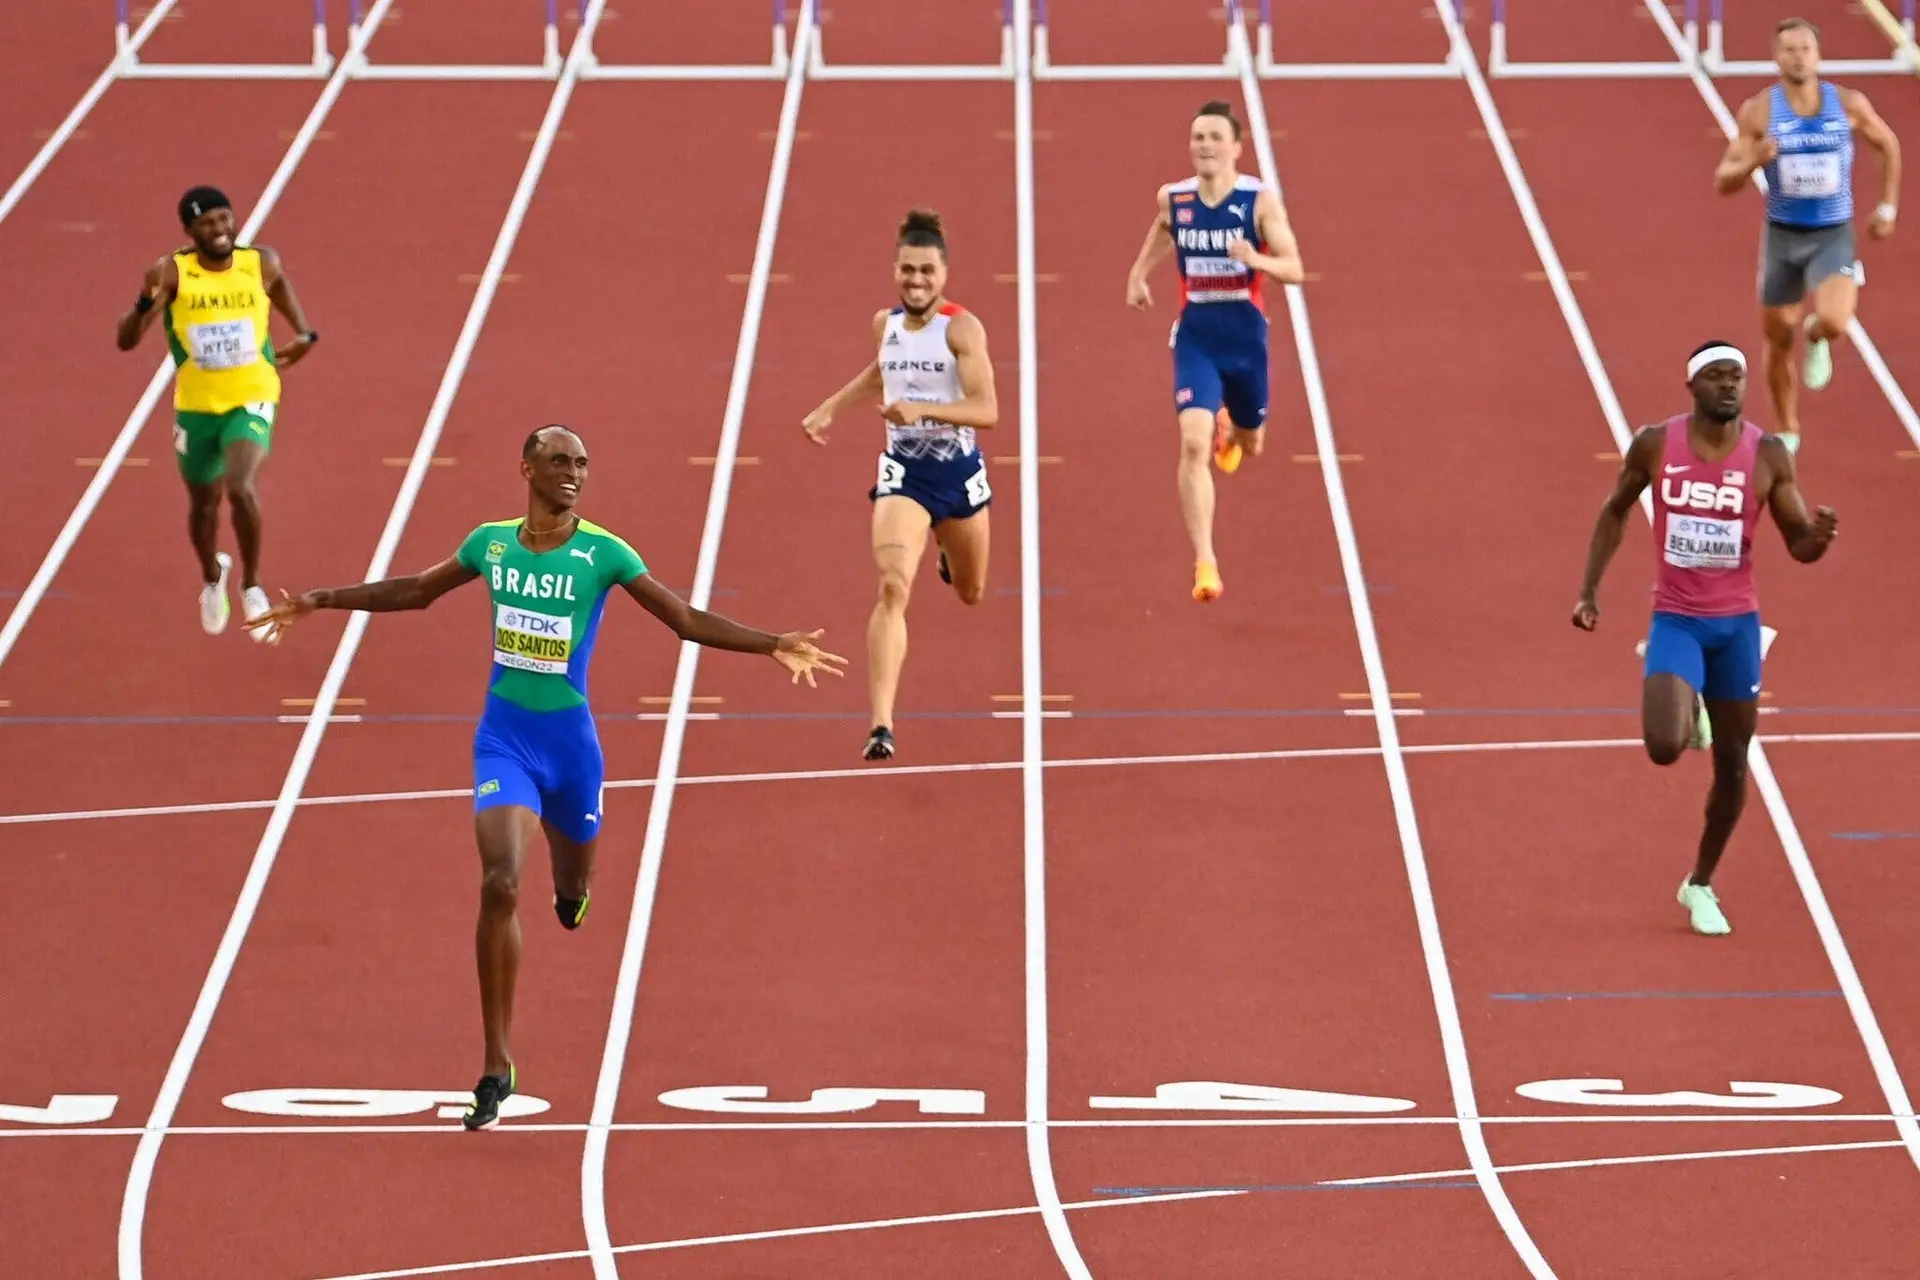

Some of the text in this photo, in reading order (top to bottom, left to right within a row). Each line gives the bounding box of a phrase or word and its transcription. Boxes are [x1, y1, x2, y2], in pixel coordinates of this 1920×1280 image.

[1178, 228, 1244, 250] NORWAY
[189, 292, 256, 311] JAMAICA
[881, 361, 945, 377] FRANCE
[883, 465, 895, 482] 5
[976, 479, 985, 497] 5
[1661, 477, 1744, 514] USA
[1692, 521, 1732, 537] TDK
[1669, 535, 1736, 556] BENJAMIN
[491, 564, 576, 601] BRASIL
[518, 613, 560, 635] TDK
[496, 628, 566, 658] DOS SANTOS
[500, 653, 553, 672] OREGON22
[222, 1088, 551, 1118] 6
[658, 1085, 985, 1115] 5
[1089, 1082, 1416, 1112] 4
[1516, 1079, 1843, 1109] 3
